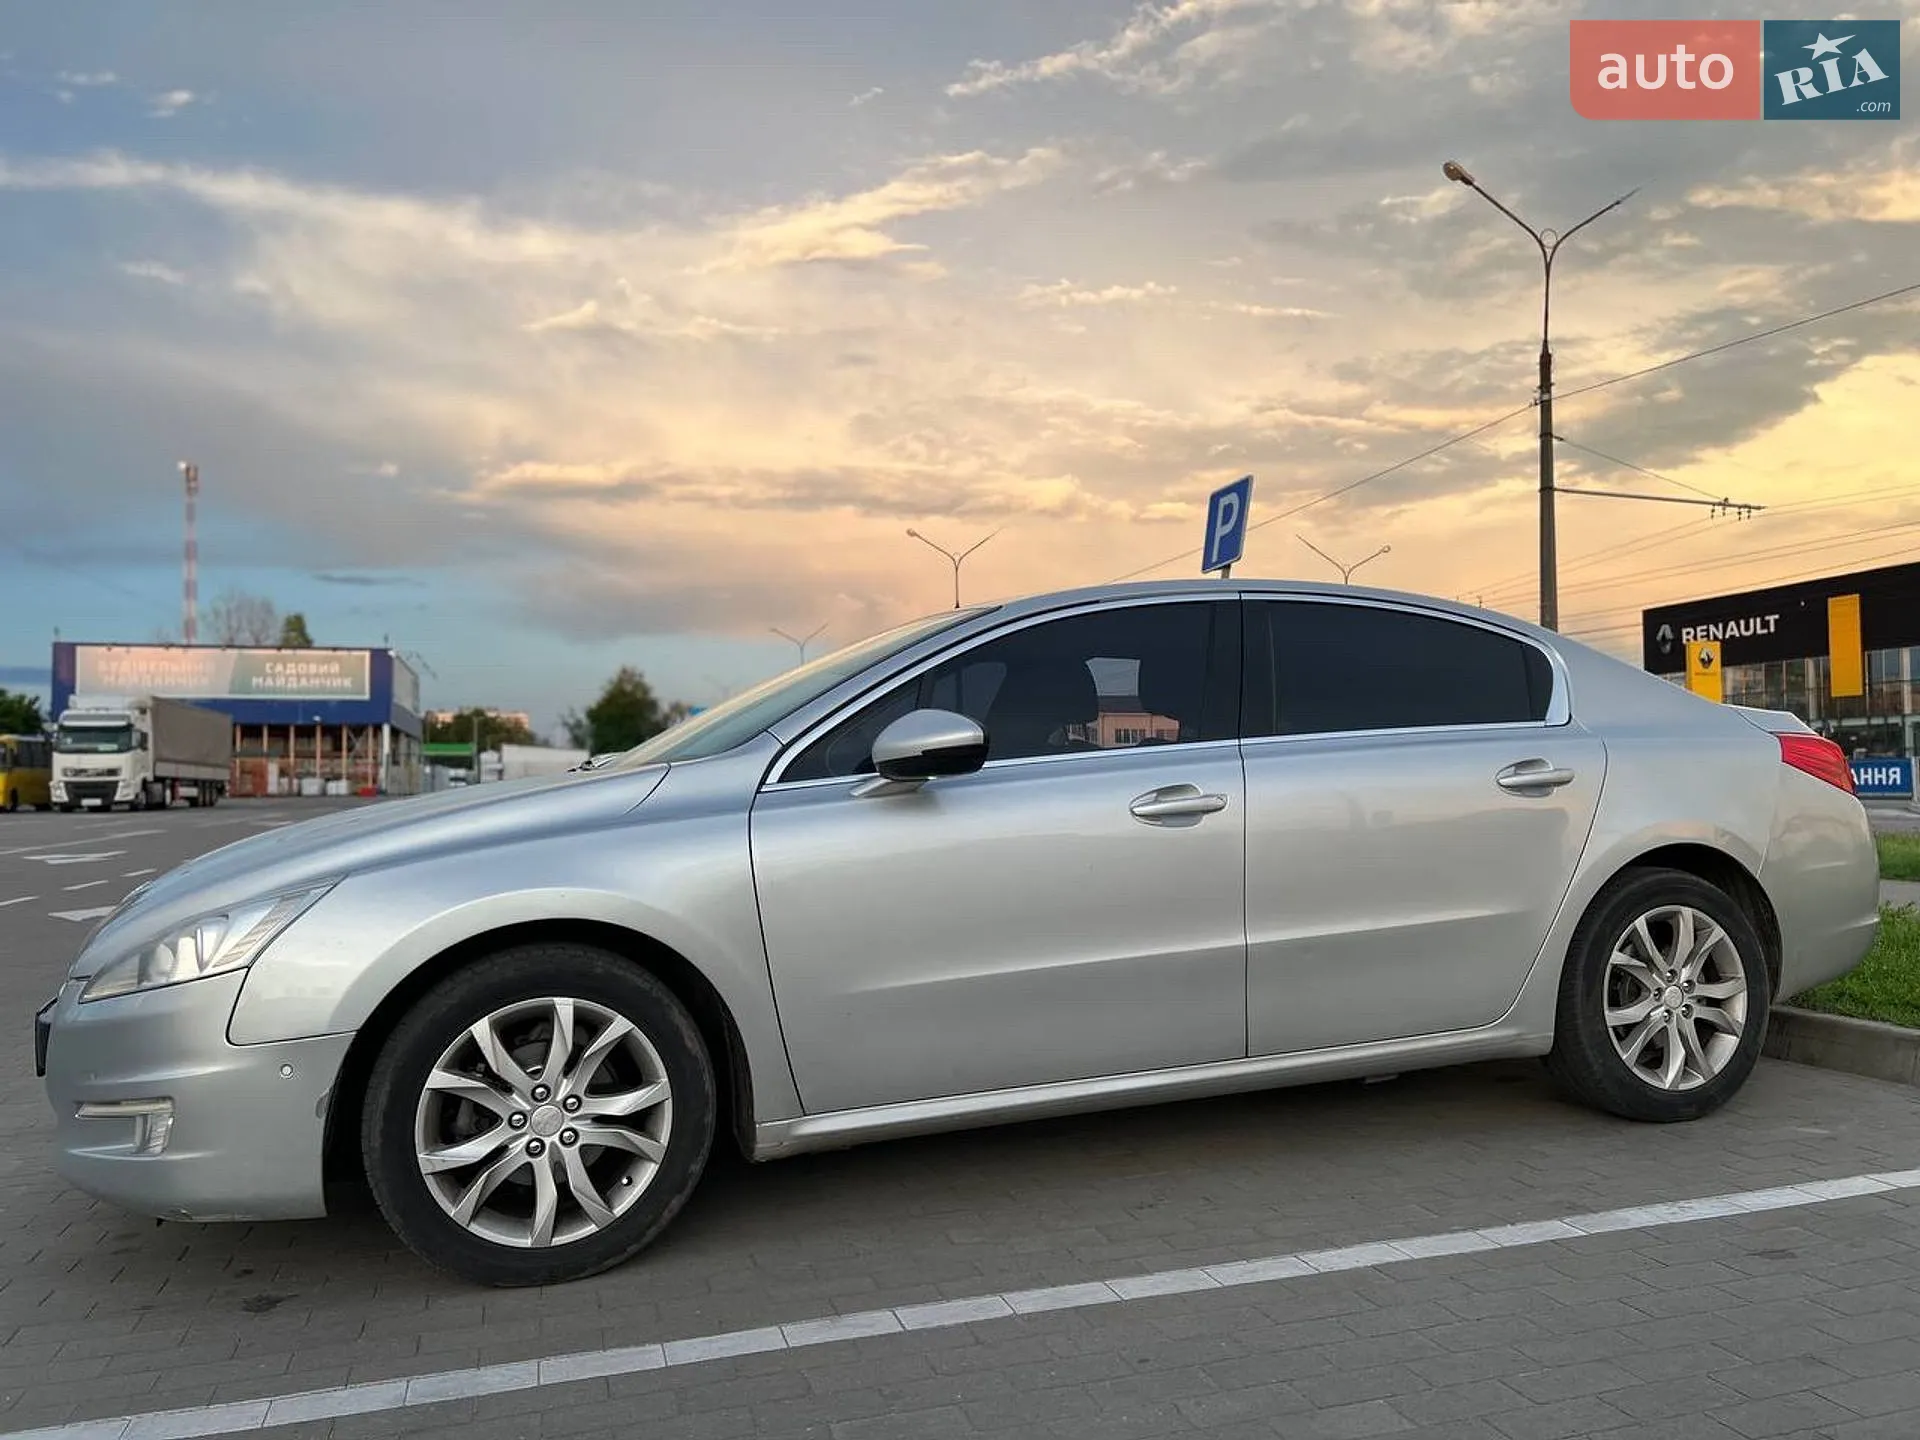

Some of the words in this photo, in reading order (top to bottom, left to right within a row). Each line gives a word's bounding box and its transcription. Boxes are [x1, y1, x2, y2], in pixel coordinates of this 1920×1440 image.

[1212, 492, 1240, 563] P
[1681, 614, 1779, 644] RENAULT
[265, 660, 341, 675] САДОВИЙ
[252, 674, 353, 689] МАЙДАНЧИК
